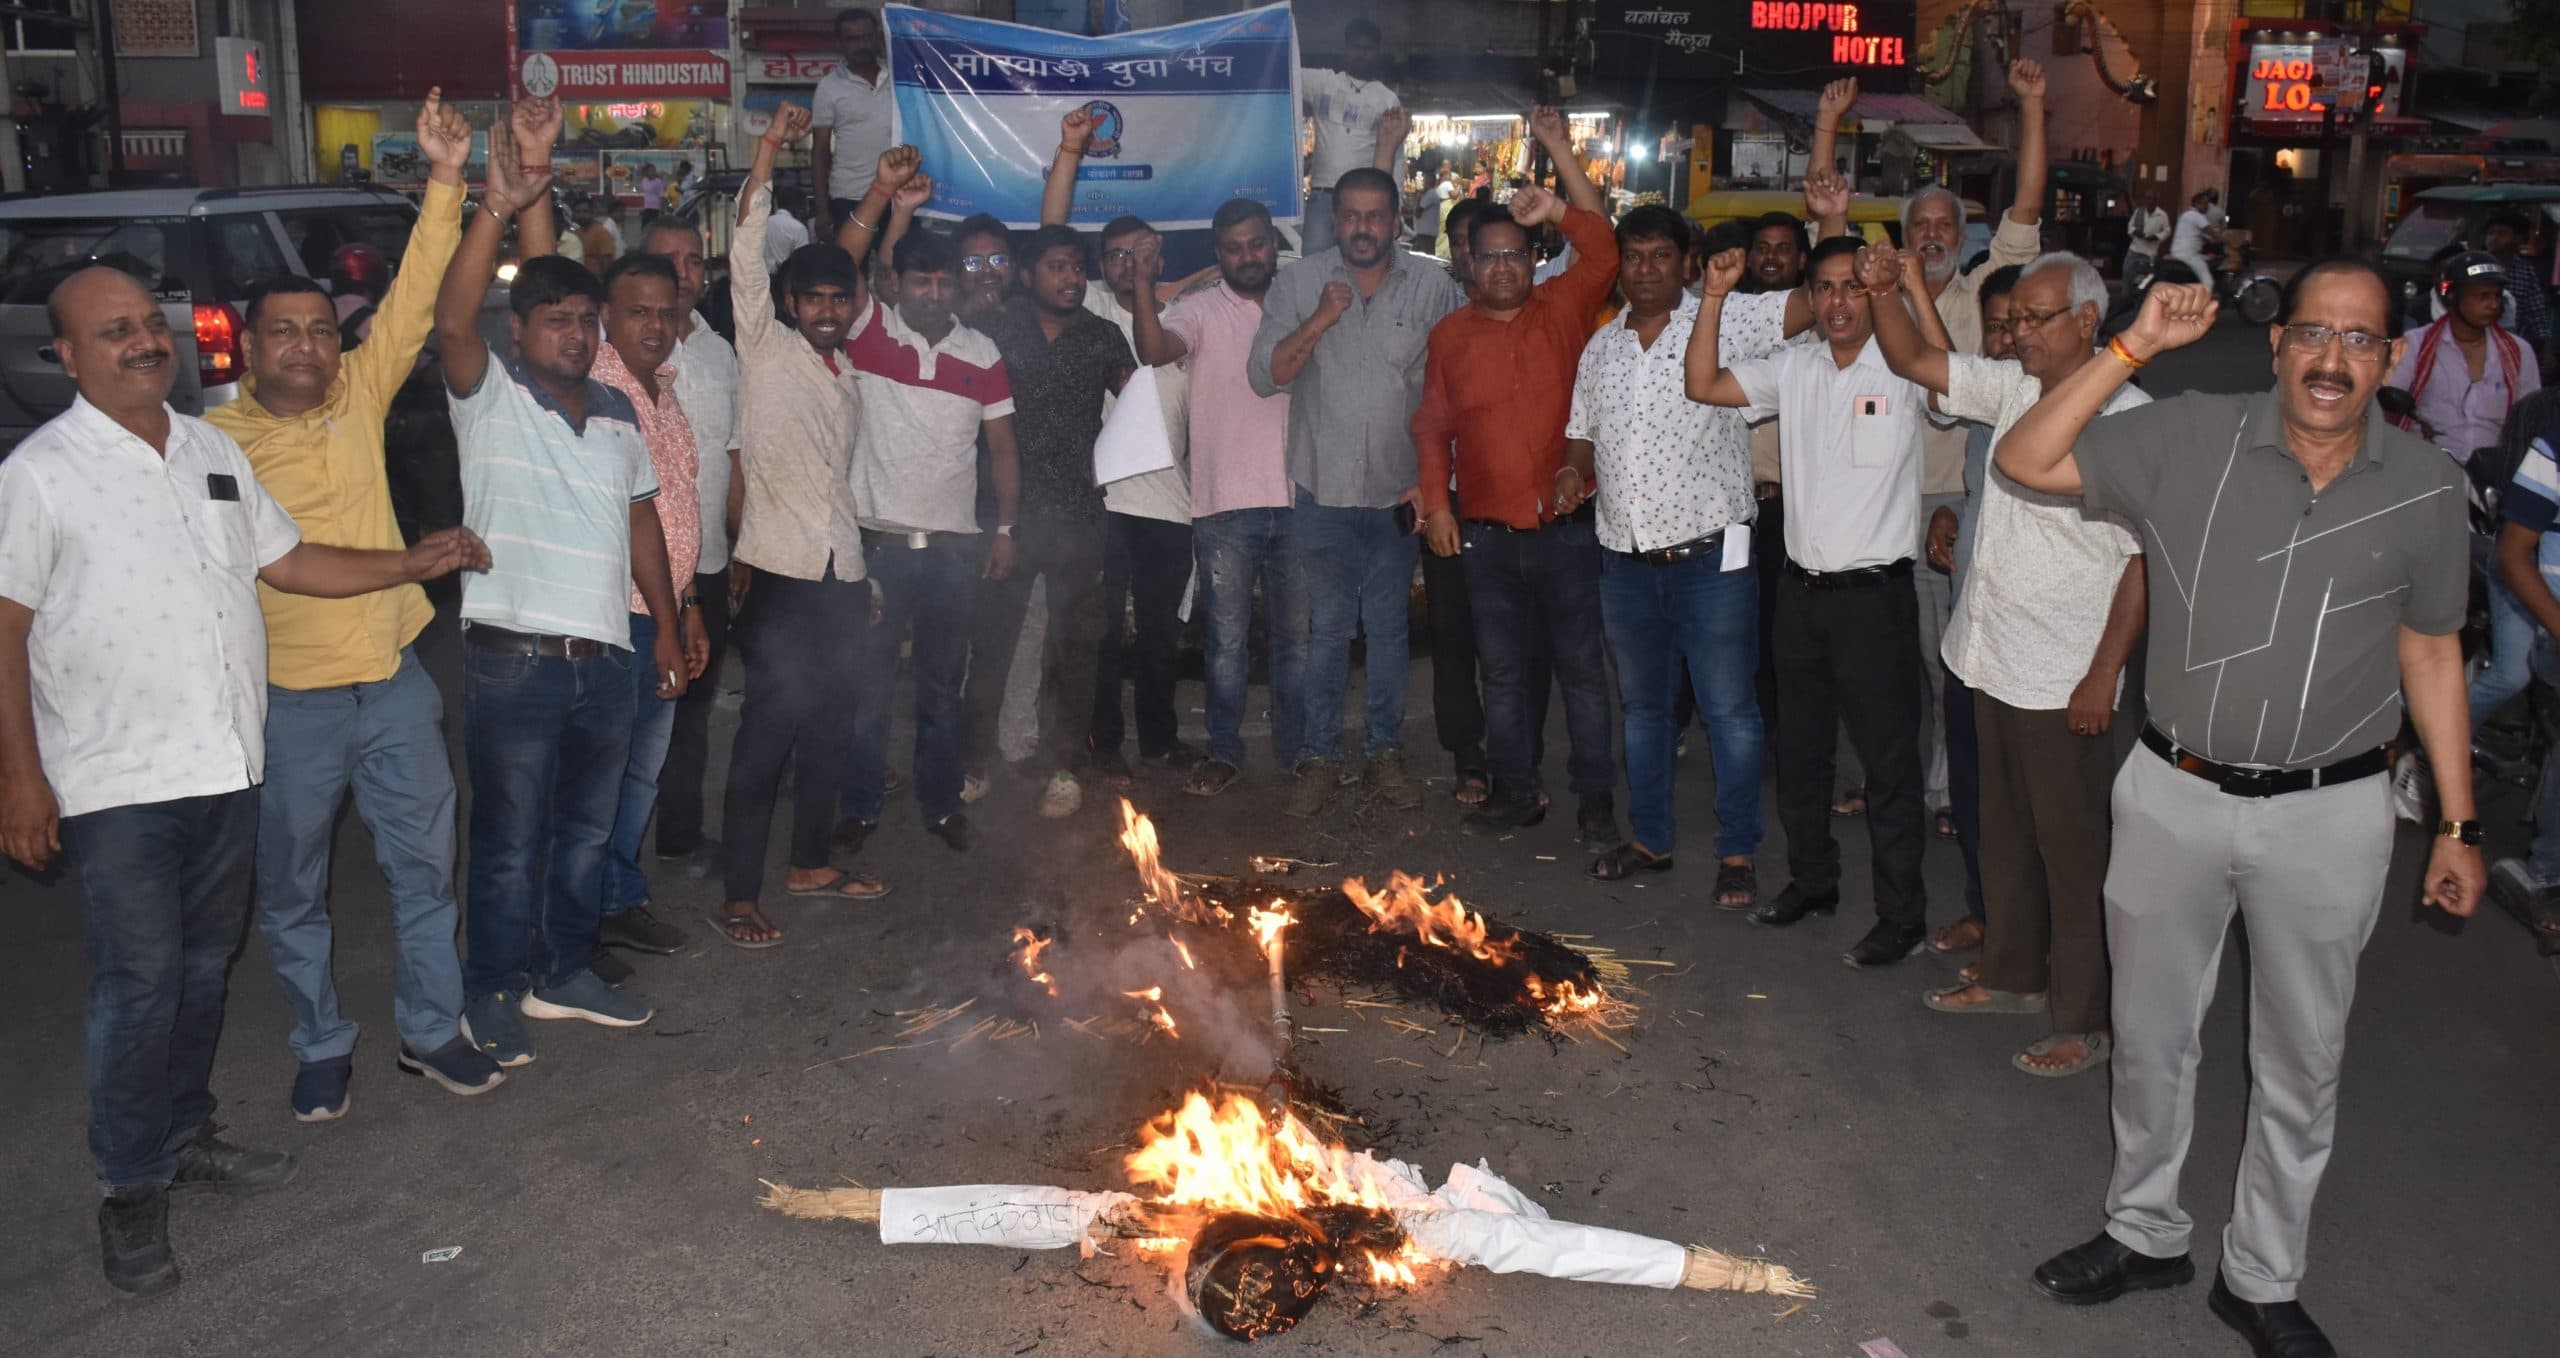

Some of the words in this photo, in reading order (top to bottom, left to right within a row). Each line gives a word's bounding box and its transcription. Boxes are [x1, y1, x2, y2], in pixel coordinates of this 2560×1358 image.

[1752, 1, 1858, 31] BHOJPUR
[1833, 36, 1905, 65] HOTEL
[560, 63, 617, 86] TRUST
[622, 63, 725, 85] HINDUSTAN
[1103, 58, 1167, 87] युवा
[1183, 50, 1234, 77] मंच
